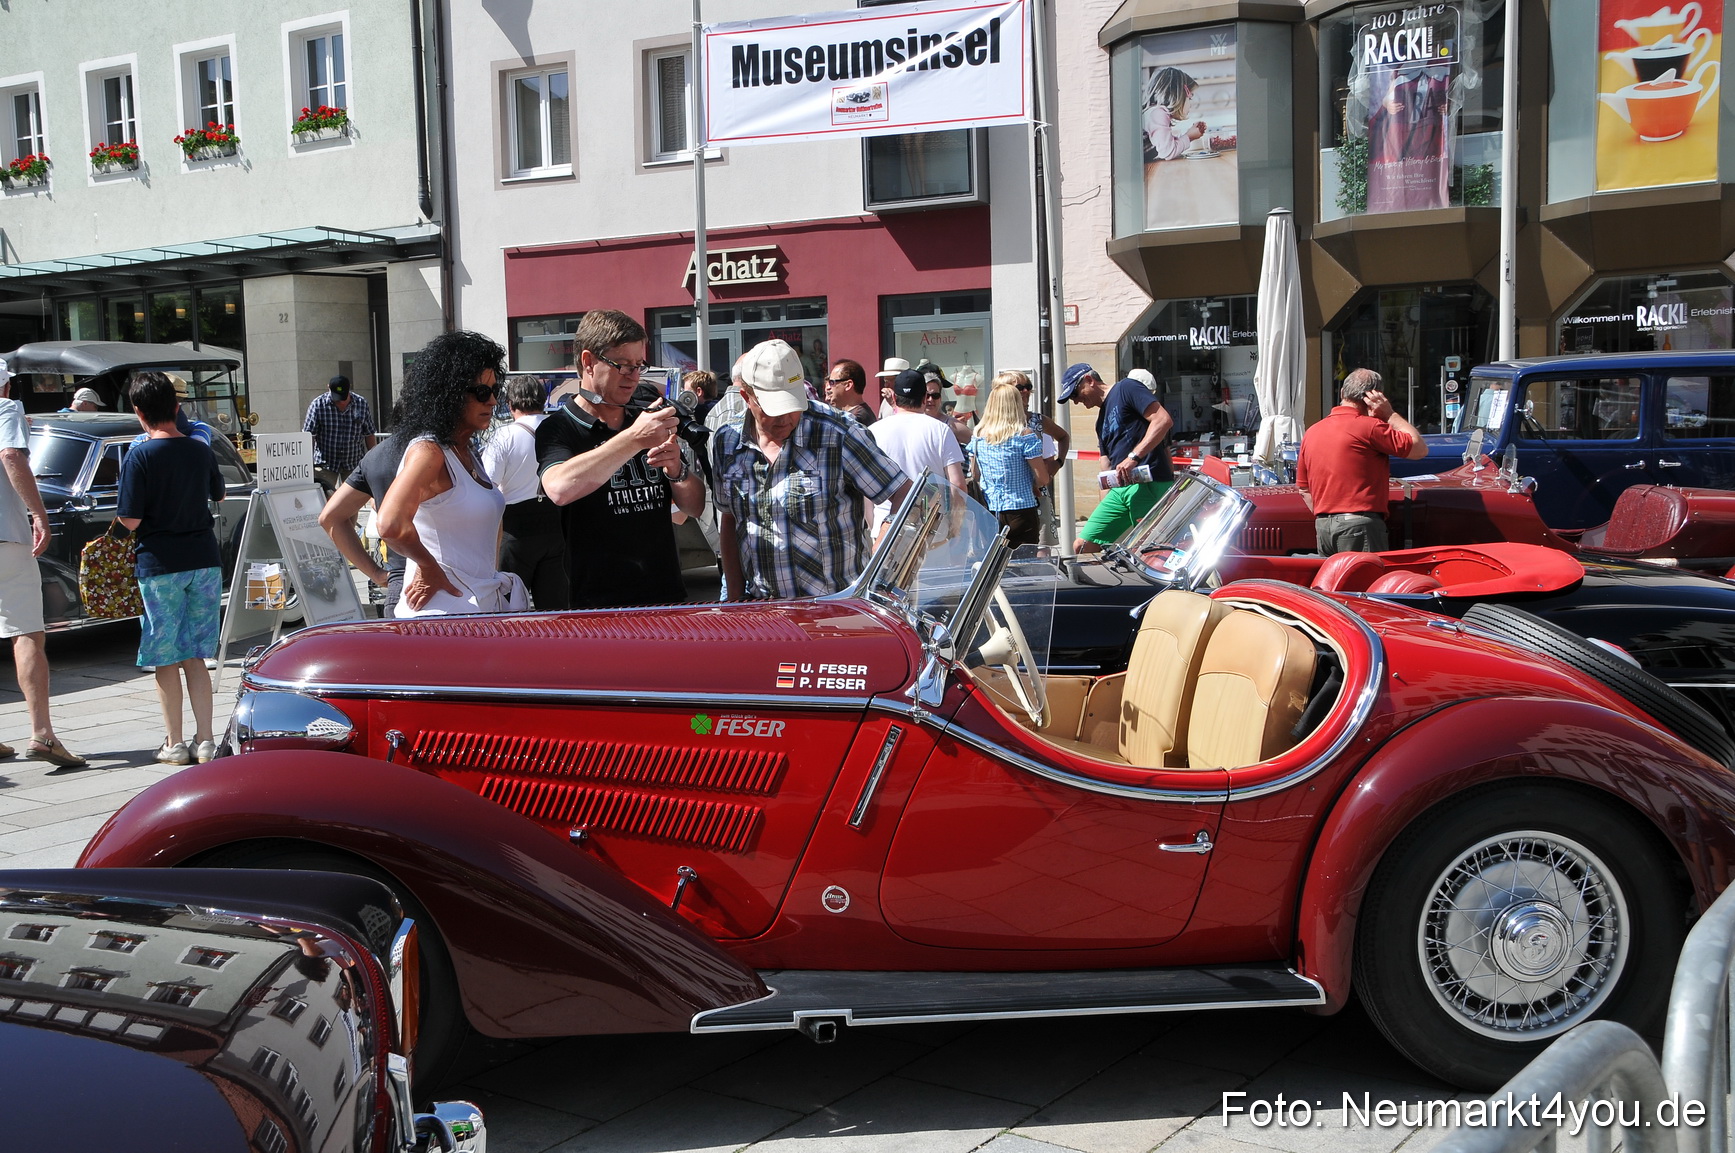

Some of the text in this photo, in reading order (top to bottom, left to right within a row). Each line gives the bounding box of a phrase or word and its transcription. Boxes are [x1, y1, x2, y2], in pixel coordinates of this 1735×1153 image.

[1370, 3, 1445, 31] 100 Jahre
[731, 16, 1001, 89] Museumsinsel
[1364, 26, 1433, 66] RACKL
[681, 250, 778, 288] Achatz
[279, 312, 289, 324] 22
[1563, 314, 1620, 325] Willkommen
[1621, 313, 1634, 321] im
[1636, 302, 1687, 327] RACKL
[920, 332, 957, 346] Achatz
[1131, 333, 1177, 343] Willkommen
[1178, 332, 1188, 341] im
[1189, 325, 1230, 346] RACKL
[1232, 330, 1257, 338] Erlebn
[265, 441, 302, 457] WELTWEIT
[262, 464, 310, 482] EINZIGARTIG
[607, 484, 665, 506] ATHLETICS
[634, 502, 654, 512] ISLAND
[800, 662, 868, 676] U. FESER
[799, 676, 866, 690] P. FESER
[714, 718, 786, 738] FESER
